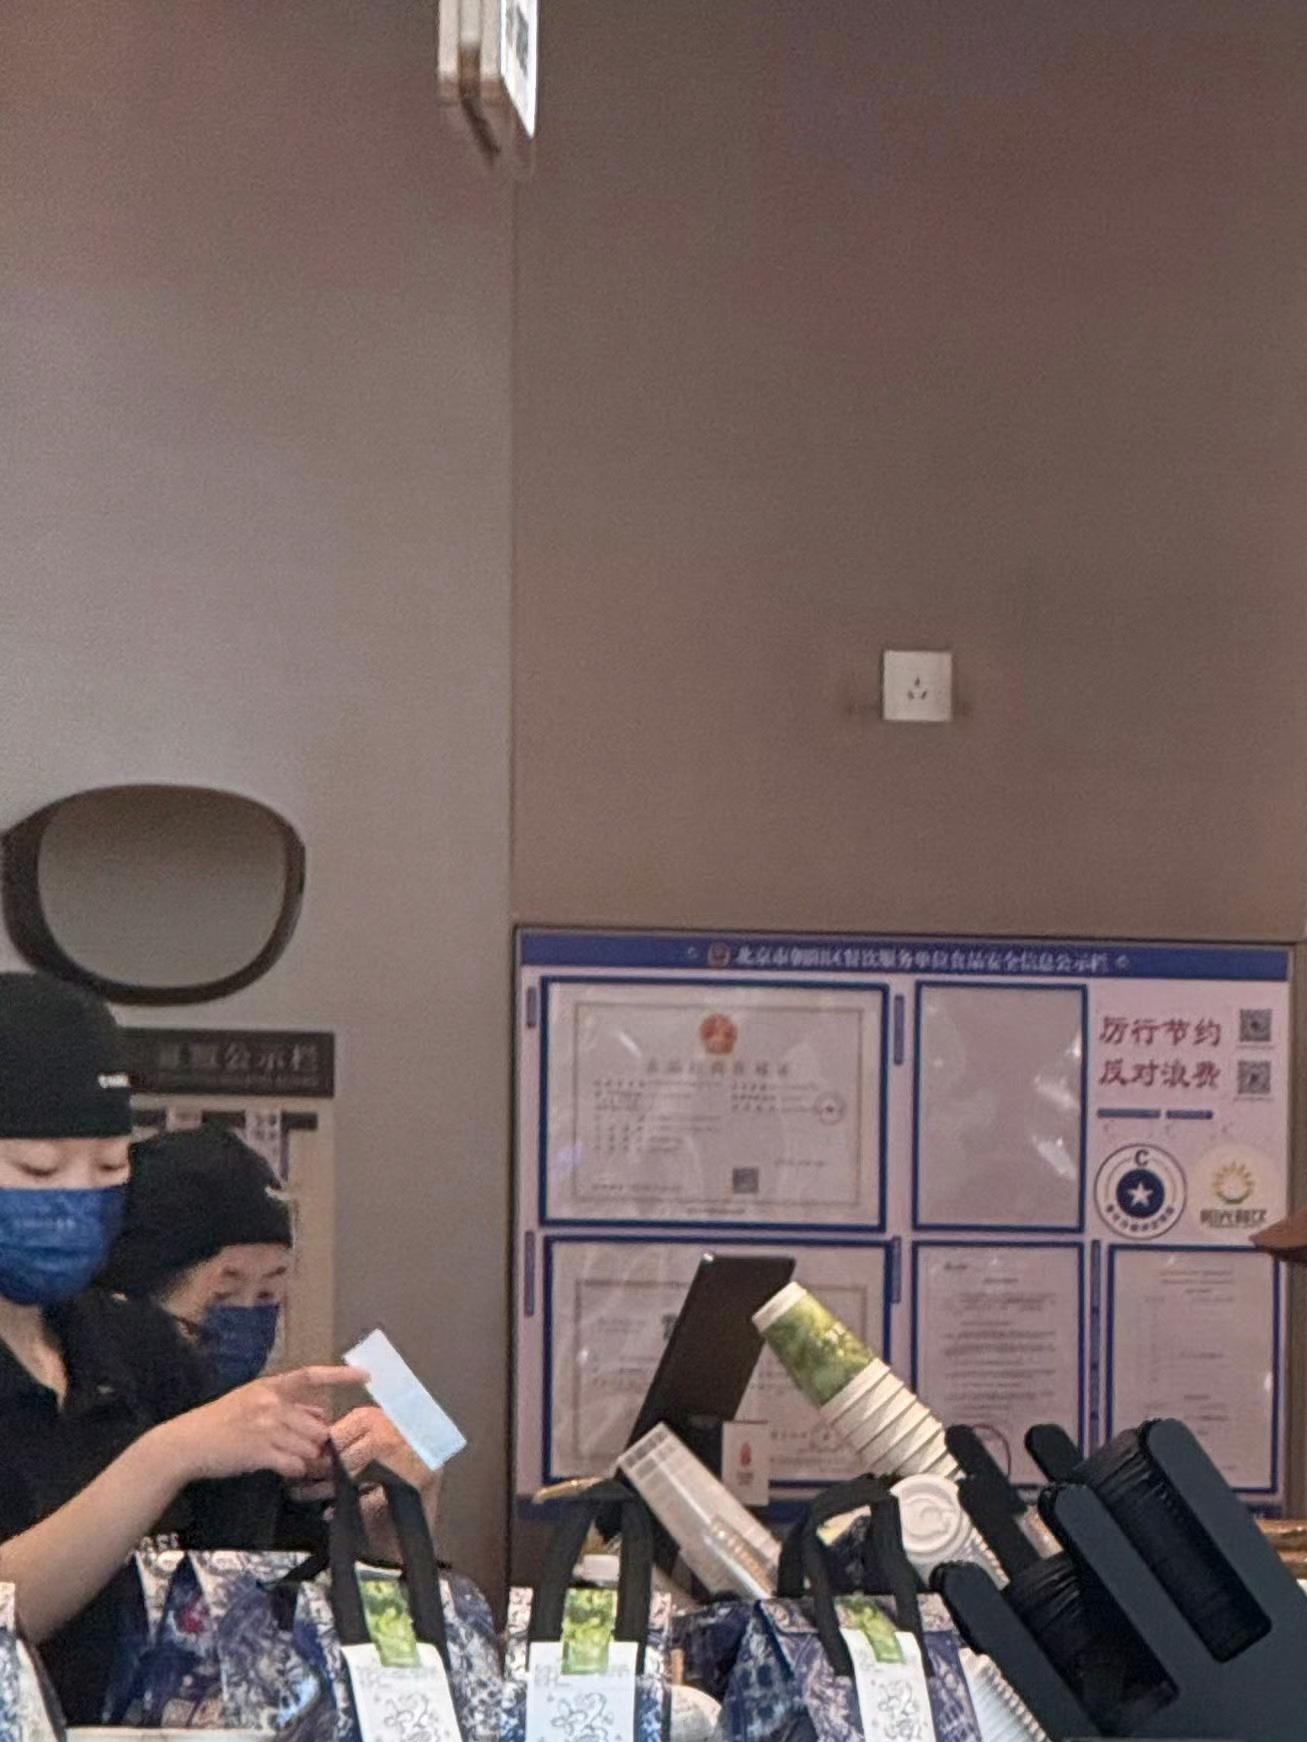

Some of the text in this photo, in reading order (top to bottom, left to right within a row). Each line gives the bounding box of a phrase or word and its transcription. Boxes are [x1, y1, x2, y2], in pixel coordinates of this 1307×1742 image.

[1100, 1016, 1221, 1047] 厉行节约
[1099, 1058, 1221, 1088] 反对浪费
[1134, 1149, 1149, 1167] C
